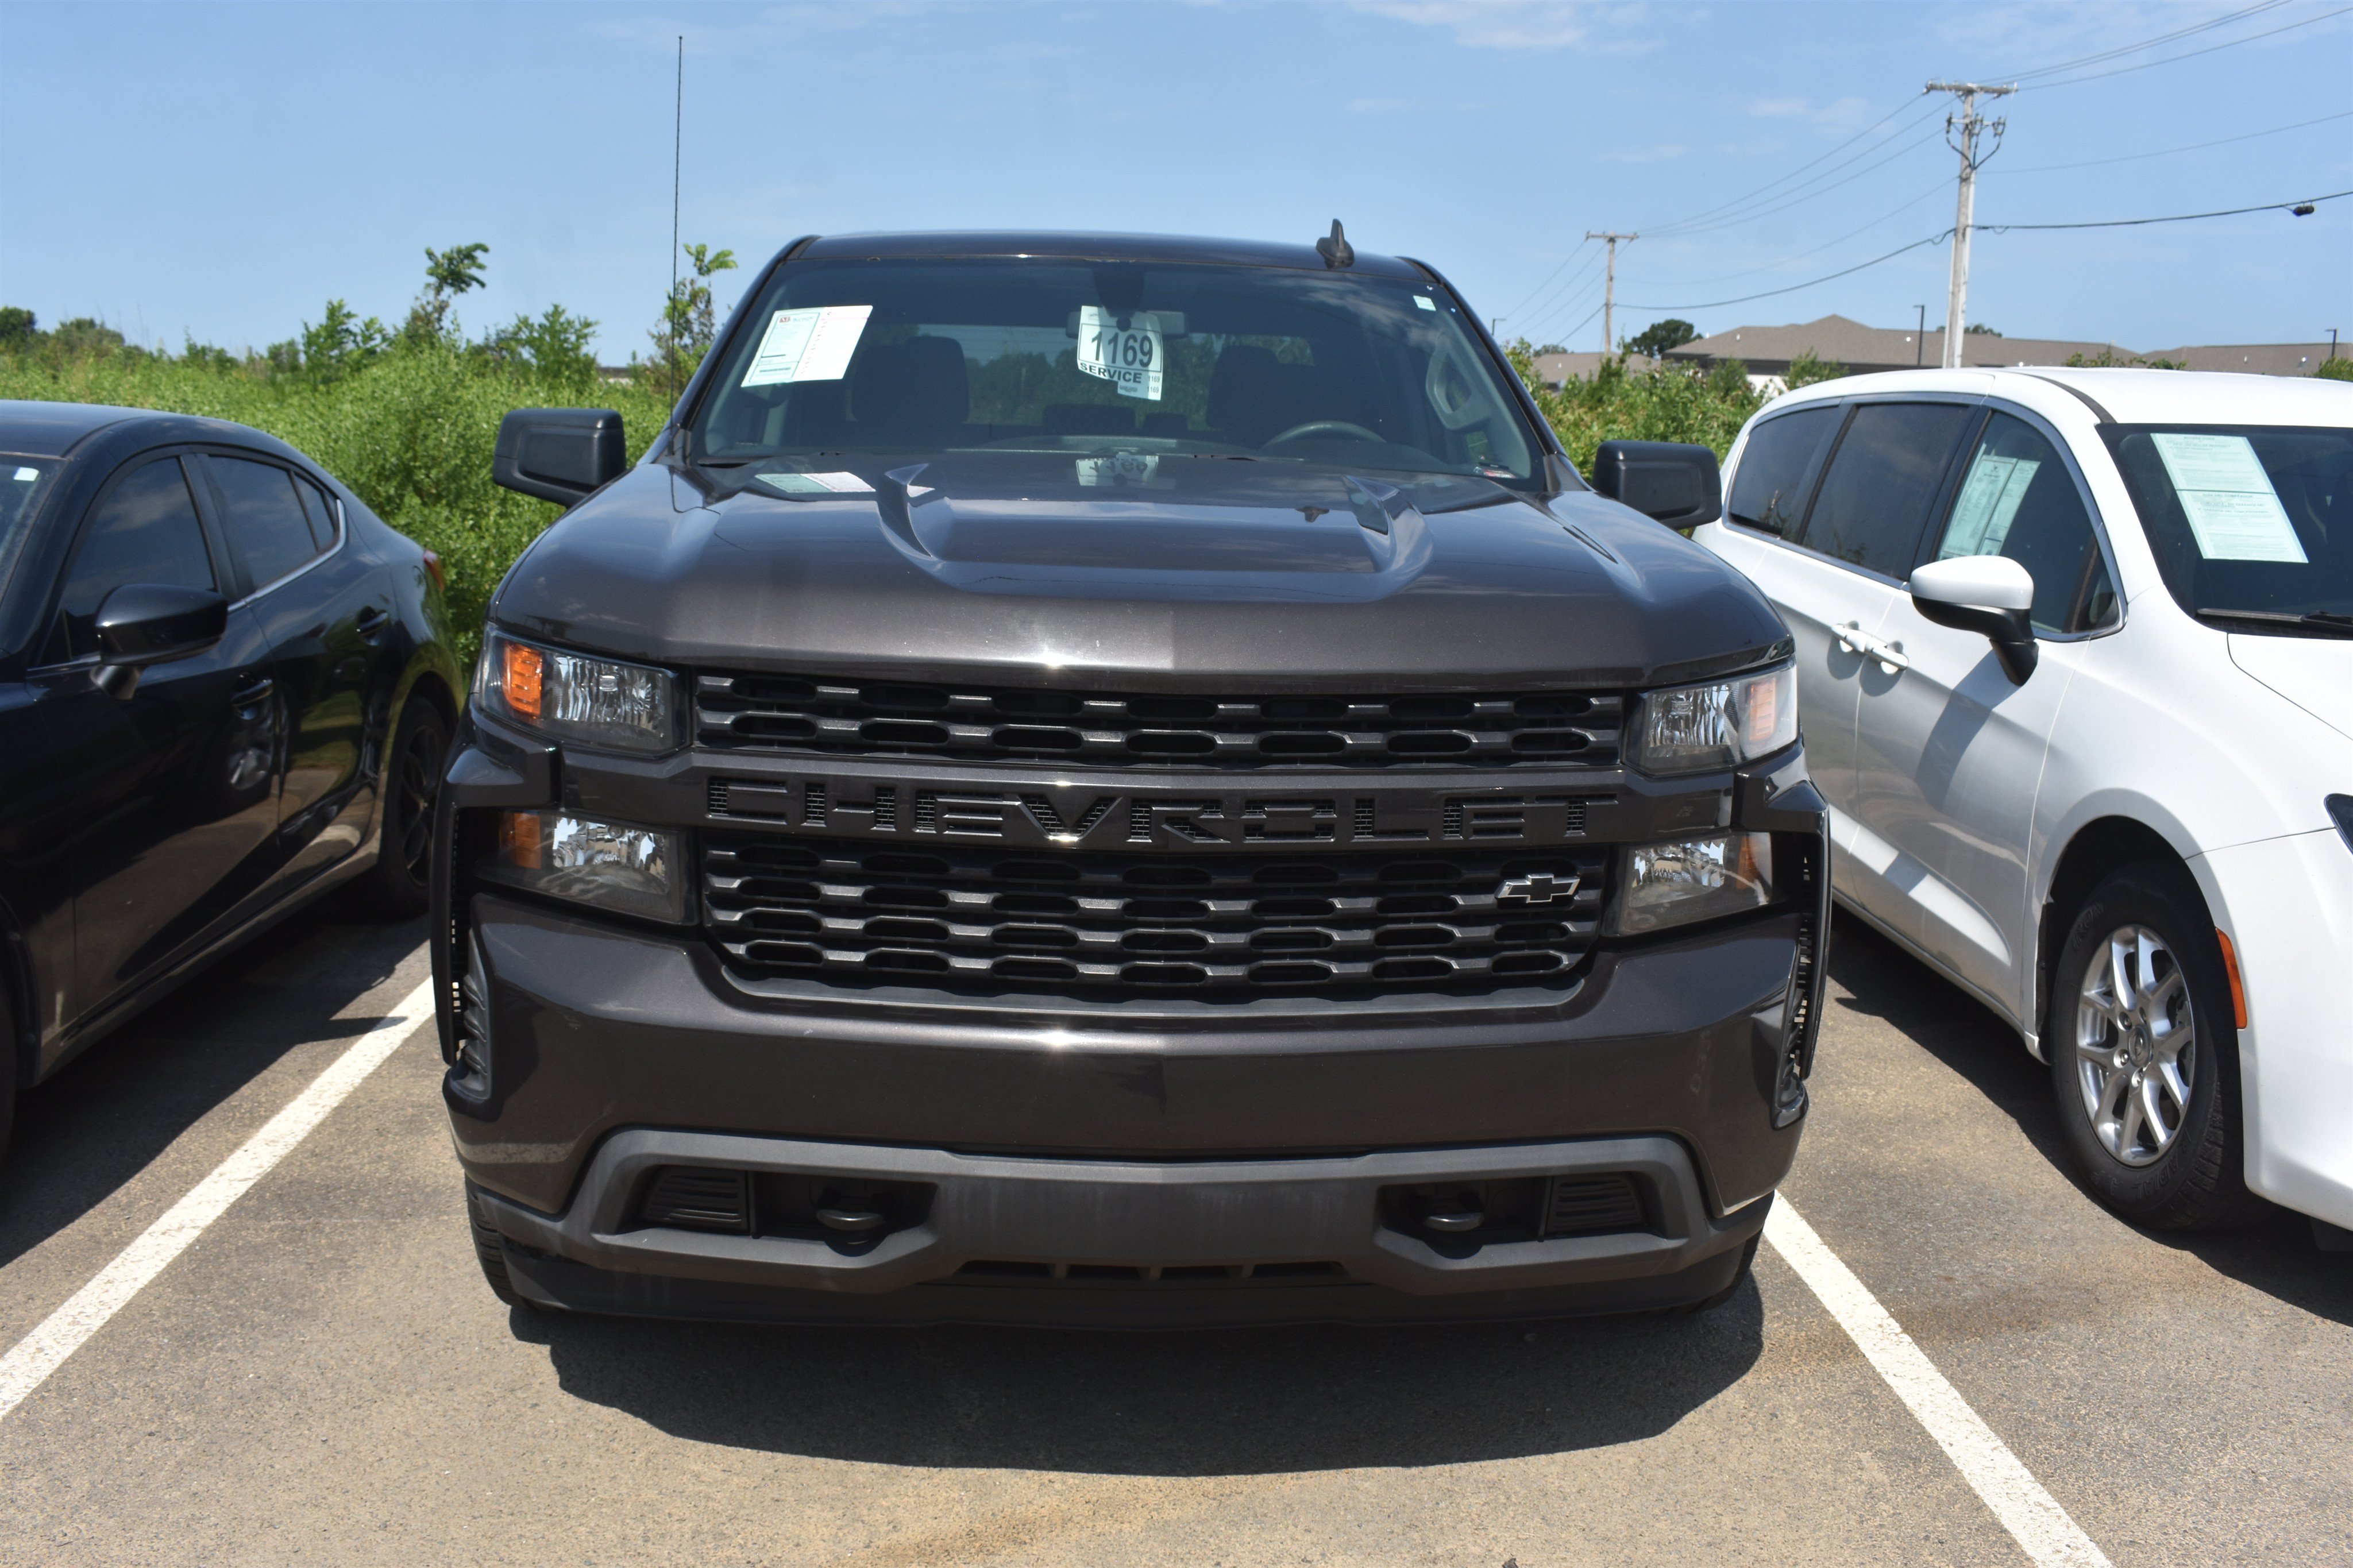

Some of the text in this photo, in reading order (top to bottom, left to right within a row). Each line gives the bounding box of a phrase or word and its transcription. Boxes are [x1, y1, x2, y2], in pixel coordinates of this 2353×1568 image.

[1091, 331, 1153, 368] 1169
[1080, 362, 1142, 384] SERVICE
[705, 777, 1619, 843] CHEVROLET
